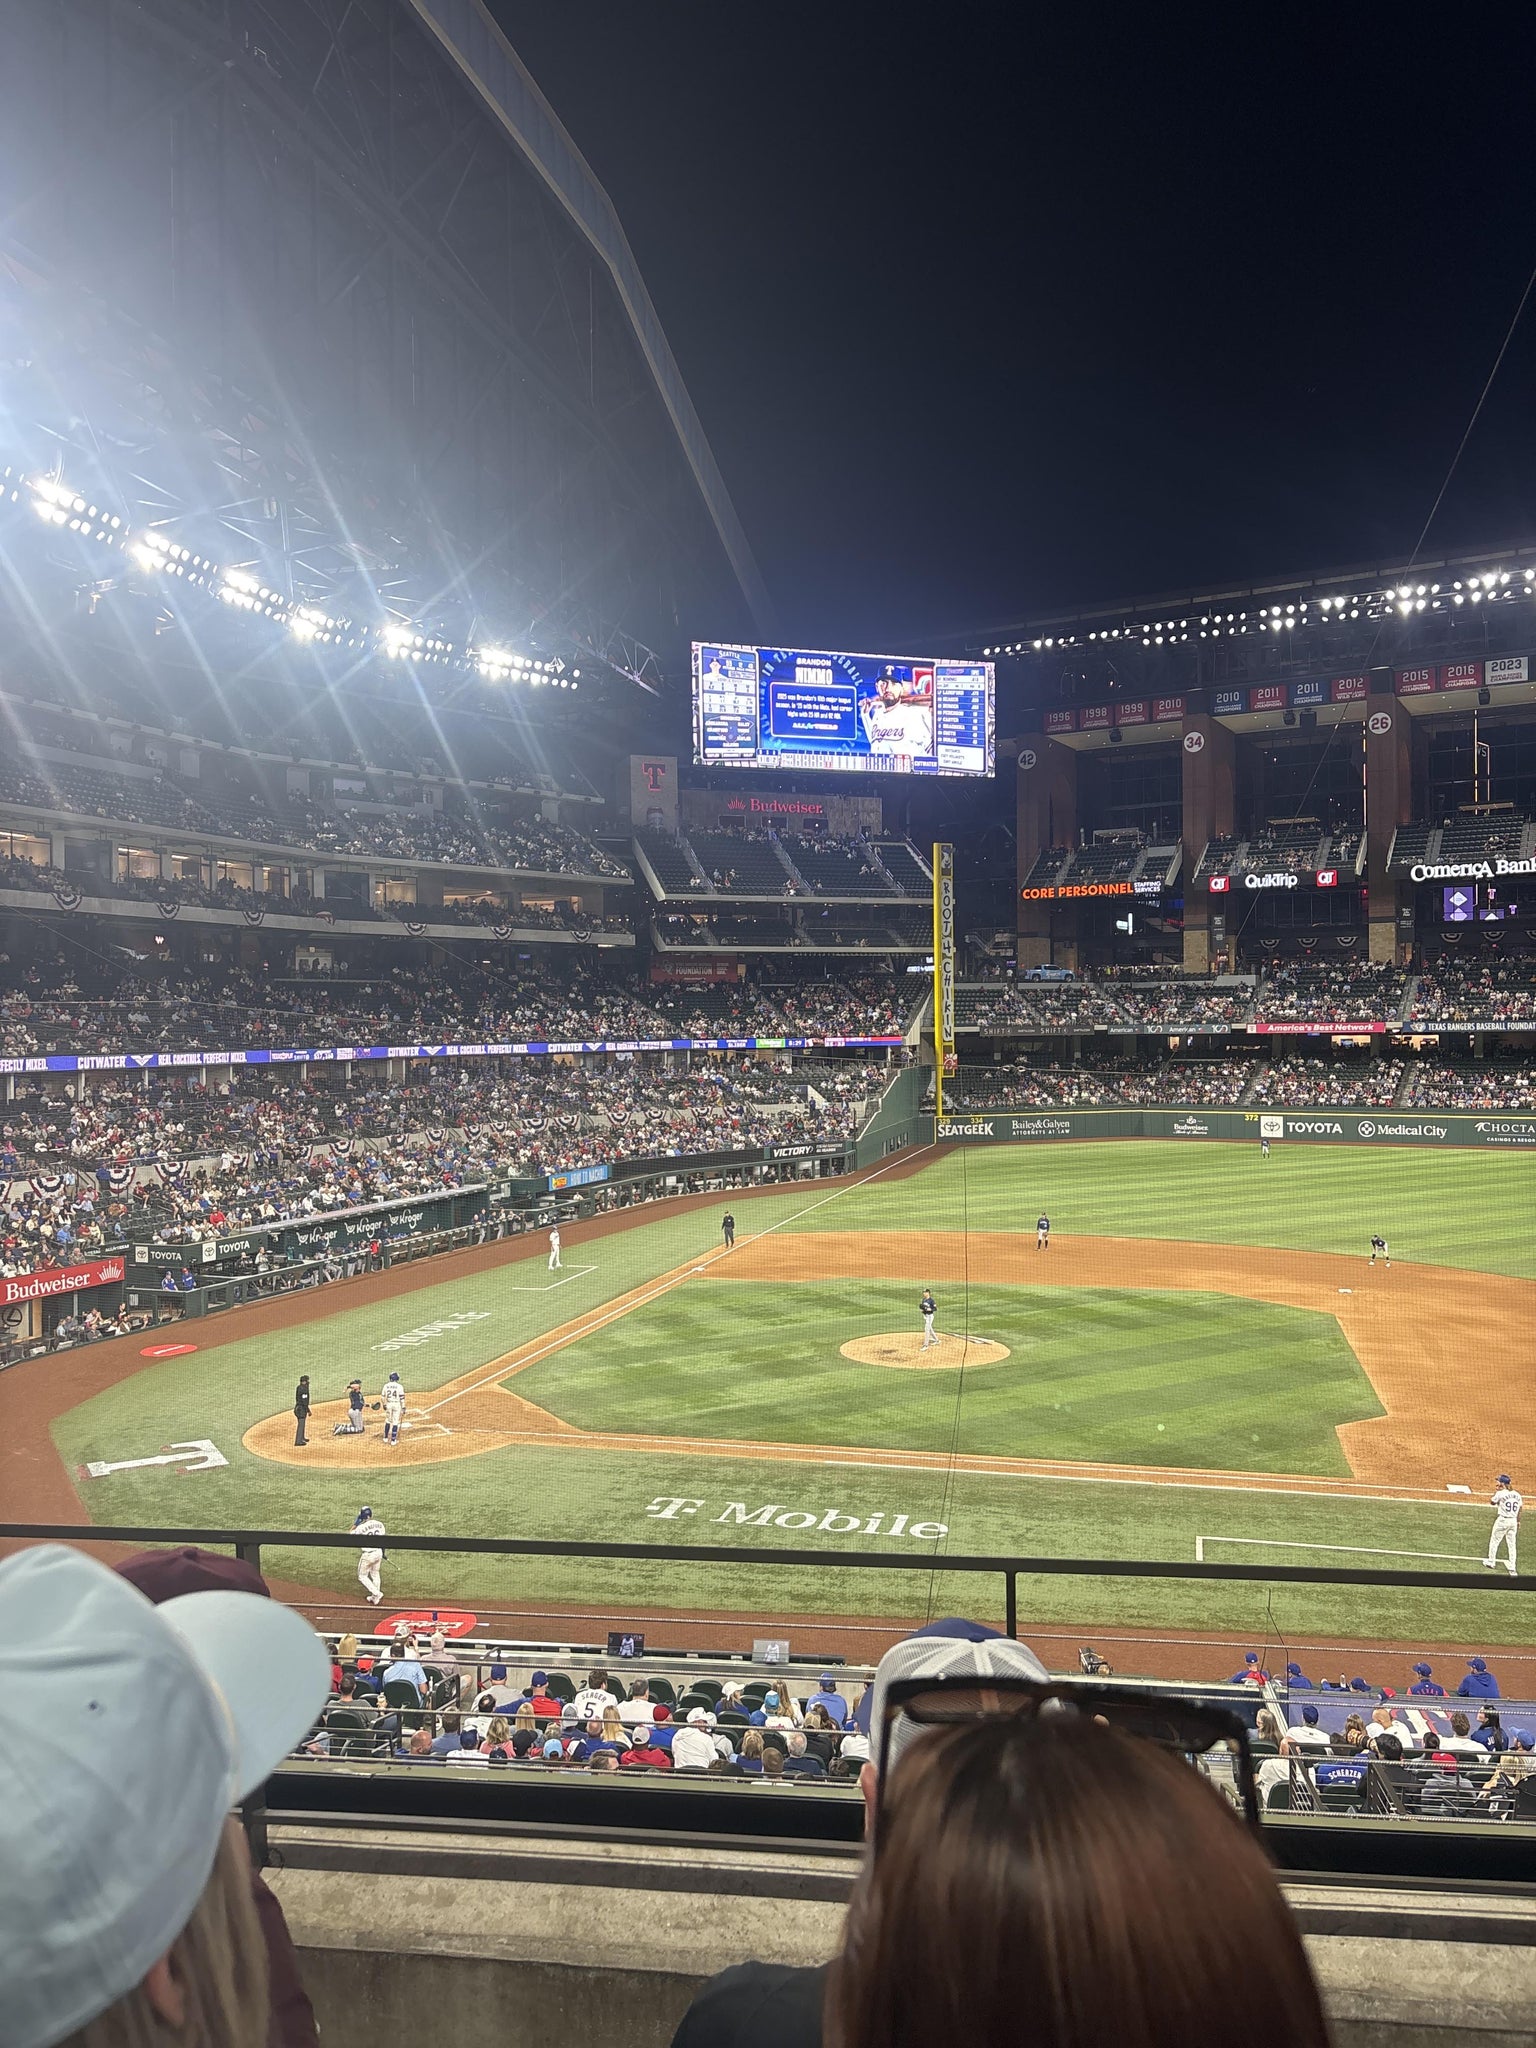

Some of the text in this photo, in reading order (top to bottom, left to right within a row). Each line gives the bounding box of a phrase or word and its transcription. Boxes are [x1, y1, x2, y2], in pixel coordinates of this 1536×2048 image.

[796, 657, 832, 667] BRANDON
[1491, 659, 1522, 672] 2023
[795, 667, 833, 685] NIMMO
[1402, 670, 1429, 682] 2015
[1447, 665, 1475, 678] 2016
[1297, 682, 1319, 695] 2011
[1338, 677, 1364, 690] 2012
[1400, 685, 1431, 693] CHAMPIONS
[1445, 680, 1477, 688] CHAMPIONS
[1216, 691, 1240, 703] 2010
[1257, 687, 1279, 699] 2011
[1121, 703, 1143, 715] 1999
[1158, 698, 1182, 710] 2010
[1049, 711, 1071, 723] 1996
[1085, 707, 1107, 718] 1998
[1371, 716, 1389, 730] 26
[1187, 736, 1203, 748] 34
[1020, 753, 1034, 765] 42
[1210, 877, 1226, 891] QT
[1244, 873, 1298, 889] QuikTrip
[1317, 871, 1335, 885] QT
[1133, 880, 1162, 889] STAFFING
[1022, 882, 1134, 900] CORE PERSONNEL
[943, 883, 951, 933] ROOT
[943, 941, 951, 953] 4
[675, 966, 713, 975] FOUNDATION
[943, 961, 952, 1038] CHIKIN
[1267, 1023, 1374, 1033] America's Best Network
[1427, 1023, 1446, 1032] TEXAS
[1446, 1022, 1475, 1031] RANGERS
[1475, 1021, 1506, 1031] BASEBALL
[387, 1046, 419, 1057] CUTWATER
[547, 1043, 583, 1053] CUTWATER
[77, 1055, 128, 1069] CUTWATER
[937, 1122, 994, 1137] SEATGEEK
[1012, 1118, 1070, 1130] Bailey&Galyen
[1173, 1123, 1209, 1131] Budweiser
[1287, 1121, 1343, 1134] TOYOTA
[1377, 1124, 1448, 1139] Medical City
[399, 1208, 423, 1229] Kroger
[355, 1217, 382, 1238] Kroger
[219, 1240, 251, 1254] TOYOTA
[150, 1251, 182, 1261] TOYOTA
[5, 1271, 91, 1302] Budweiser
[386, 1390, 397, 1399] 24
[1505, 1501, 1518, 1512] 96
[710, 1501, 949, 1539] Mobile
[581, 1692, 607, 1703] SEAGER
[583, 1701, 596, 1718] 5
[1327, 1768, 1362, 1780] SCHERZER
